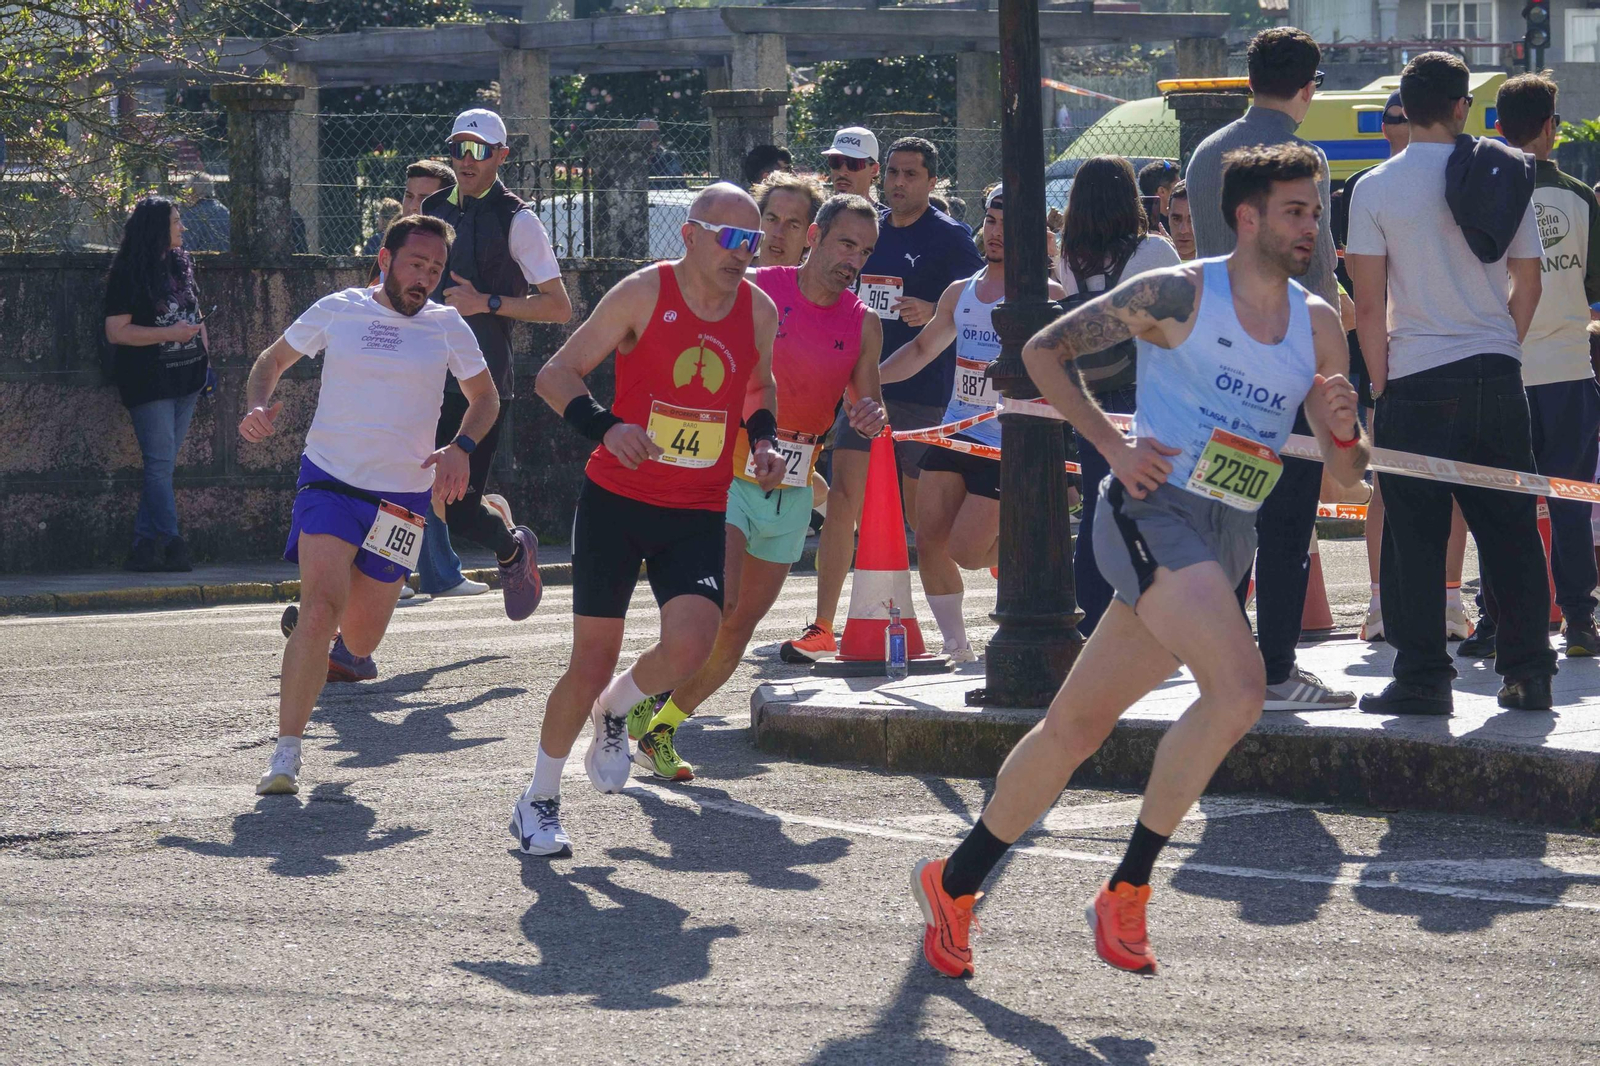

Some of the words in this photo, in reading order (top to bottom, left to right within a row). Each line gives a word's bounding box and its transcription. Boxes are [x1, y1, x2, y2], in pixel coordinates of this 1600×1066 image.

[836, 136, 861, 148] HOKA
[869, 290, 890, 310] 915
[368, 320, 400, 332] Sempre
[361, 335, 403, 345] correndo
[963, 374, 987, 397] 887
[683, 421, 698, 429] BARO
[670, 428, 700, 456] 44
[775, 447, 802, 476] 72
[1204, 453, 1270, 500] 2290
[385, 524, 416, 557] 199
